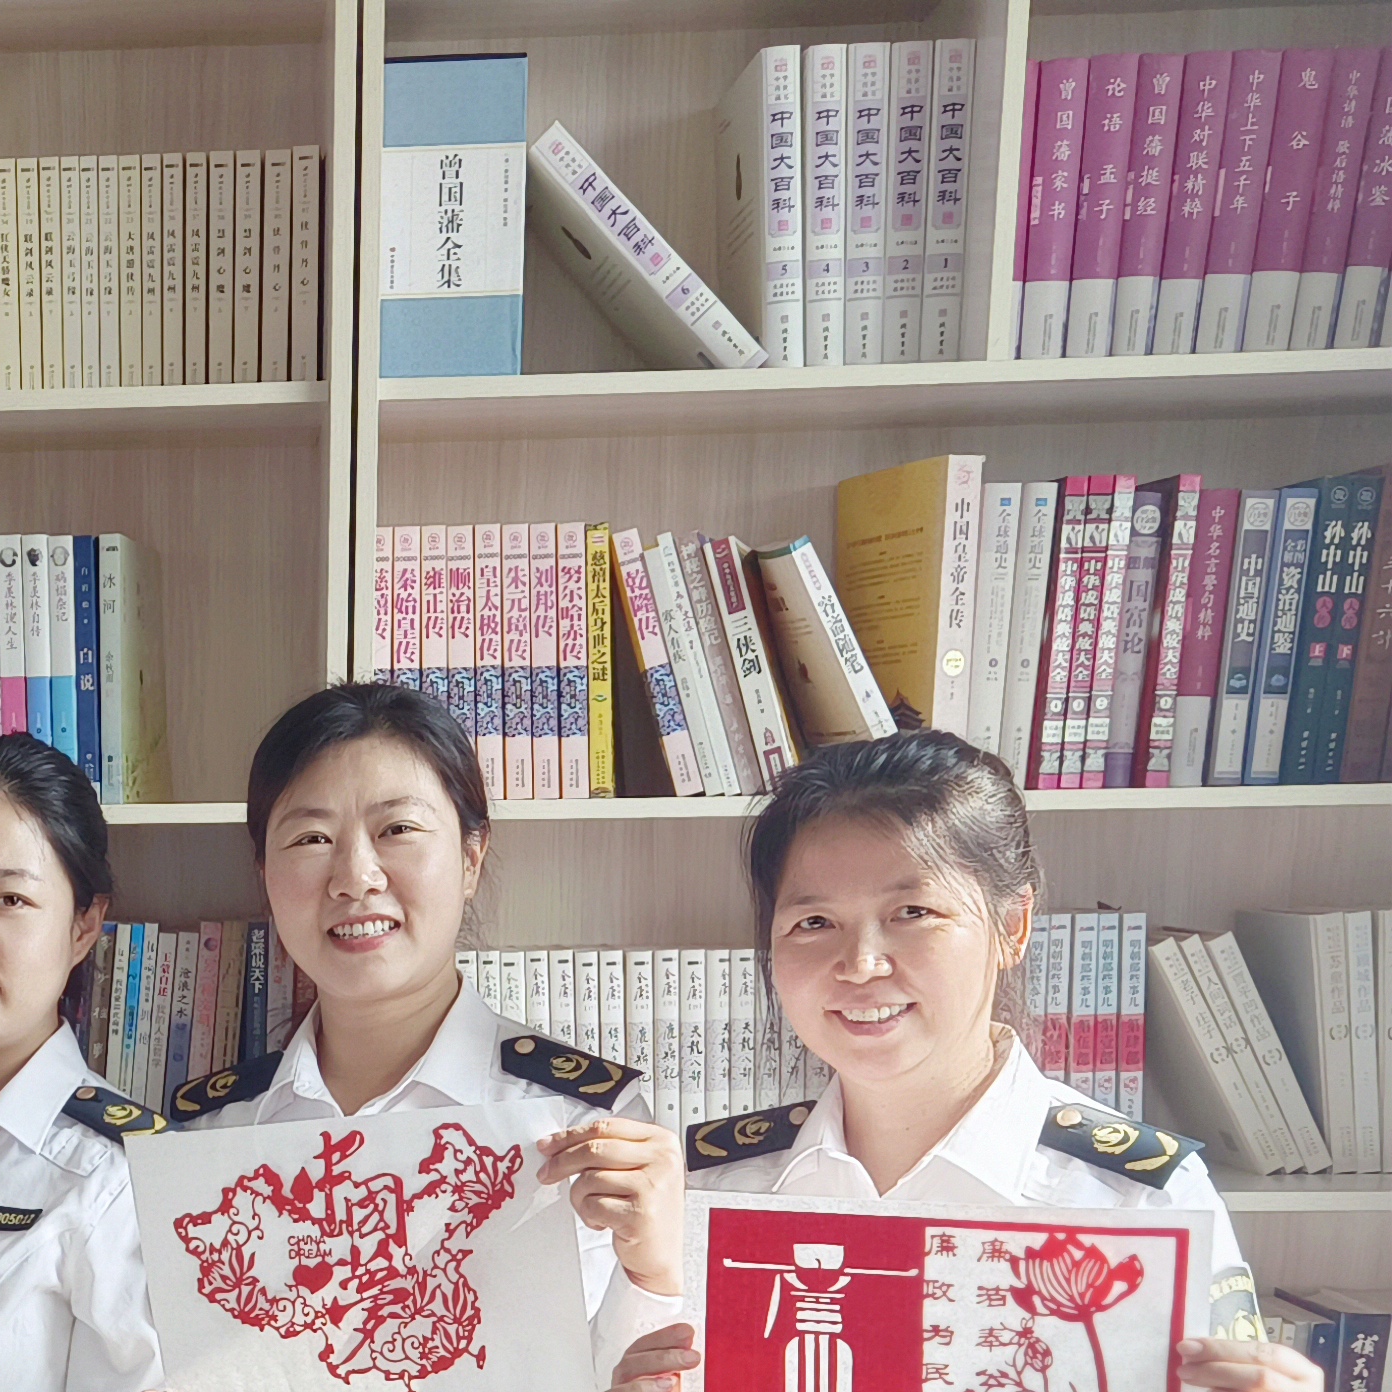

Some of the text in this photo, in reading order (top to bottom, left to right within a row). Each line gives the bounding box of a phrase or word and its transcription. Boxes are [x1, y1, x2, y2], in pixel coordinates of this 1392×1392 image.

[769, 110, 796, 213] 中国大百科
[814, 108, 840, 212] 中国大百科
[855, 107, 882, 211] 中国大百科
[896, 104, 924, 208] 中国大百科
[936, 102, 966, 206] 中国大百科
[1048, 77, 1077, 221] 曾国藩家书
[1094, 78, 1127, 219] 论语 孟子
[1136, 73, 1171, 216] 曾国藩挺经
[1229, 69, 1265, 214] 中华上下五千年
[1280, 67, 1319, 211] 鬼谷子
[436, 153, 464, 289] 曾国藩全集
[577, 171, 656, 257] 中国大百科
[680, 284, 690, 296] 6
[949, 497, 971, 629] 中国皇帝全传
[994, 508, 1012, 570] 全球通史
[1028, 508, 1048, 570] 全球通史
[1316, 520, 1345, 593] 孙中山
[1343, 521, 1372, 594] 孙中山
[395, 568, 417, 664] 秦始皇传
[424, 567, 445, 639] 雍正传
[449, 566, 471, 639] 顺治传
[478, 565, 500, 662] 皇太极传
[506, 565, 528, 662] 朱元璋传
[533, 565, 554, 639] 刘邦传
[560, 565, 584, 662] 努尔哈赤传
[625, 568, 658, 641] 乾隆传
[1122, 579, 1149, 655] 国富论
[1234, 553, 1263, 643] 中国通史
[1271, 566, 1301, 654] 资治通鉴
[729, 615, 762, 678] 三侠剑
[176, 967, 191, 1019] 沧浪之水
[249, 929, 265, 994] 老梁说天下
[287, 1234, 327, 1247] CHINA
[288, 1247, 333, 1260] DREAM
[922, 1231, 958, 1387] 廉政为民
[976, 1238, 1013, 1388] 廉洁奉公
